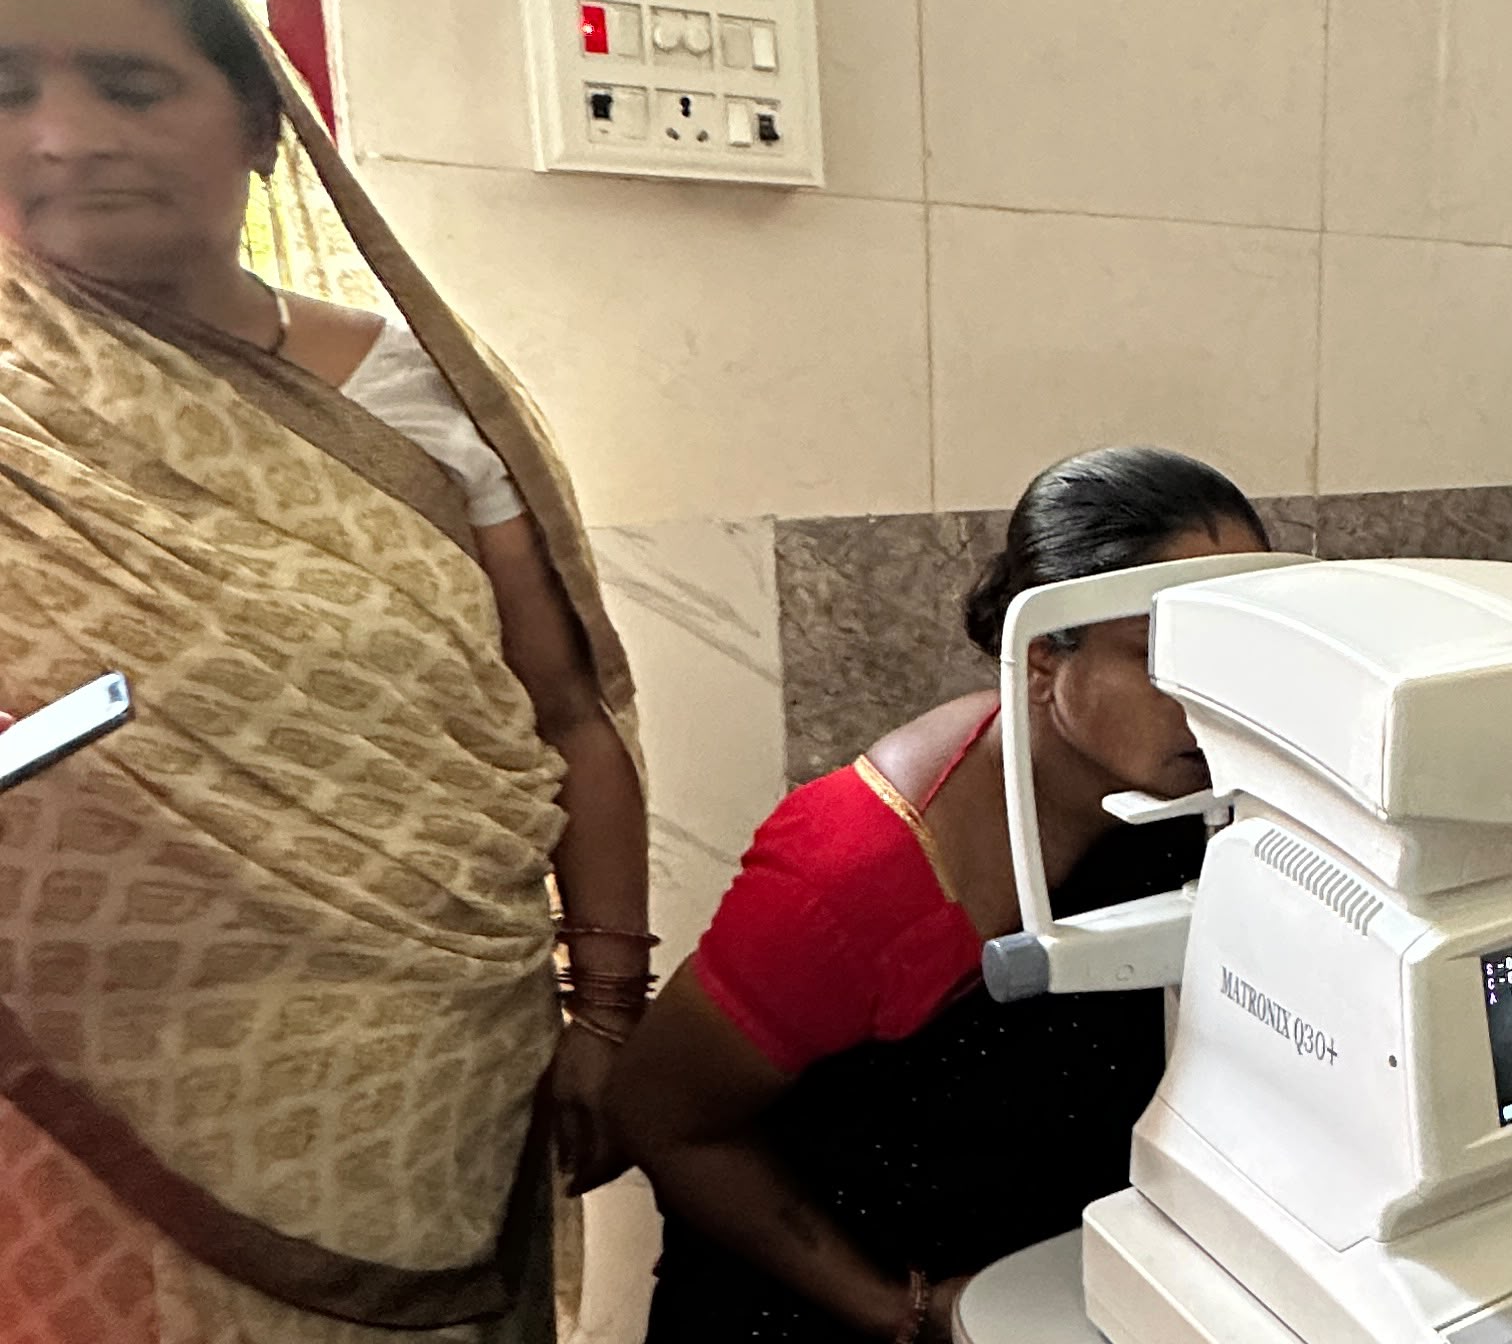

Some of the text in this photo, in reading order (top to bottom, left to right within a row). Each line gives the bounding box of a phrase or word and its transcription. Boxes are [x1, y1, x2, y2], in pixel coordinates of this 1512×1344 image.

[1486, 963, 1494, 976] S
[1487, 977, 1495, 991] C
[1489, 992, 1498, 1005] A
[1220, 965, 1338, 1066] MATRONIX Q30+
